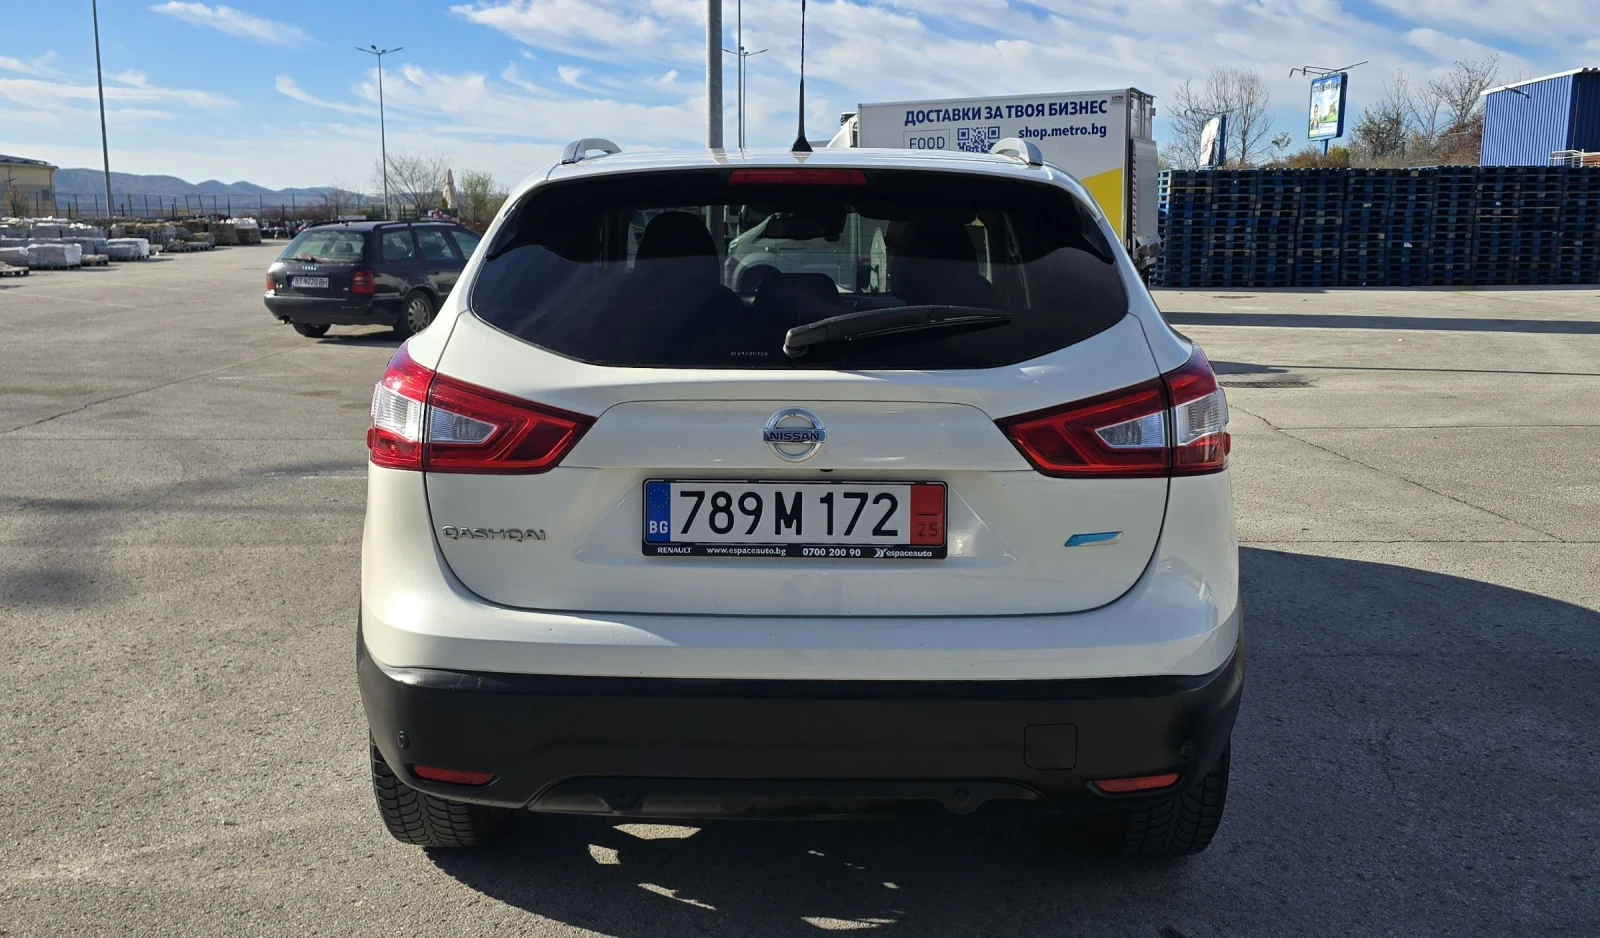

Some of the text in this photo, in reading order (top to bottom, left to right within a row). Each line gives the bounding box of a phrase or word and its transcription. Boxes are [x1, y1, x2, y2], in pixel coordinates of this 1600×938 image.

[905, 100, 1107, 126] ДОСТАВКИ ЗА ТВОЯ БИЗНЕС
[1018, 122, 1107, 138] shop.metro.bg
[909, 136, 945, 149] FOOD
[770, 432, 820, 441] NISSAN
[680, 491, 899, 536] 789 M 172
[442, 525, 546, 542] QASHQAI
[649, 521, 668, 533] BG
[918, 523, 939, 536] 25
[706, 547, 787, 556] www.espaceauto.bg
[802, 548, 861, 557] 0700 200 90
[885, 549, 933, 558] espaceauto
